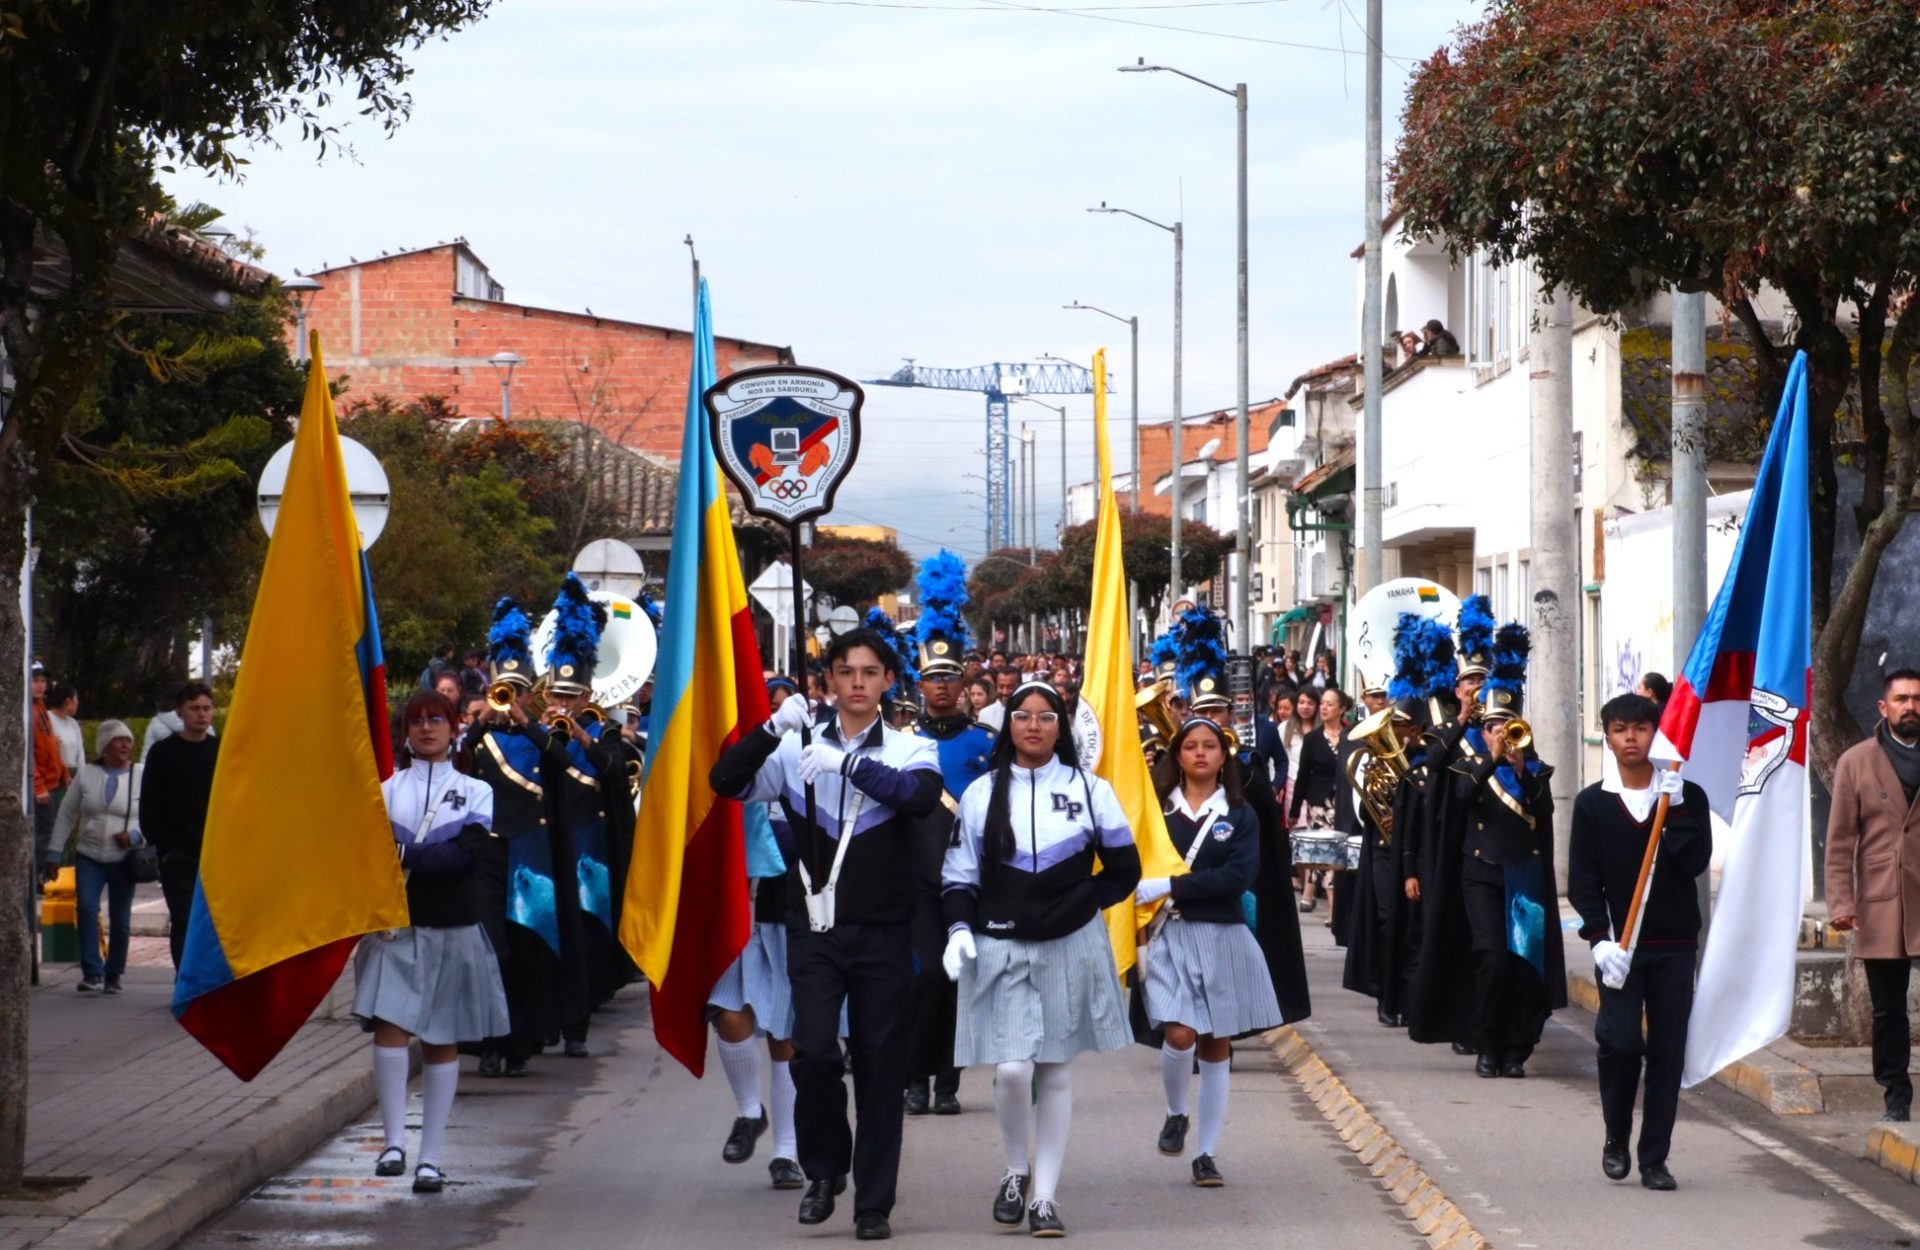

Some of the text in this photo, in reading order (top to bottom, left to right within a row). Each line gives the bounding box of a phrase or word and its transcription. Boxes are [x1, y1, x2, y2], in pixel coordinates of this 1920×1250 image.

[740, 380, 776, 390] CONVIVIR
[809, 401, 817, 409] DE
[1387, 587, 1415, 599] YAMAHA
[595, 674, 640, 702] NCIPA
[1081, 710, 1097, 770] DE TOCAN
[1051, 792, 1083, 822] DP
